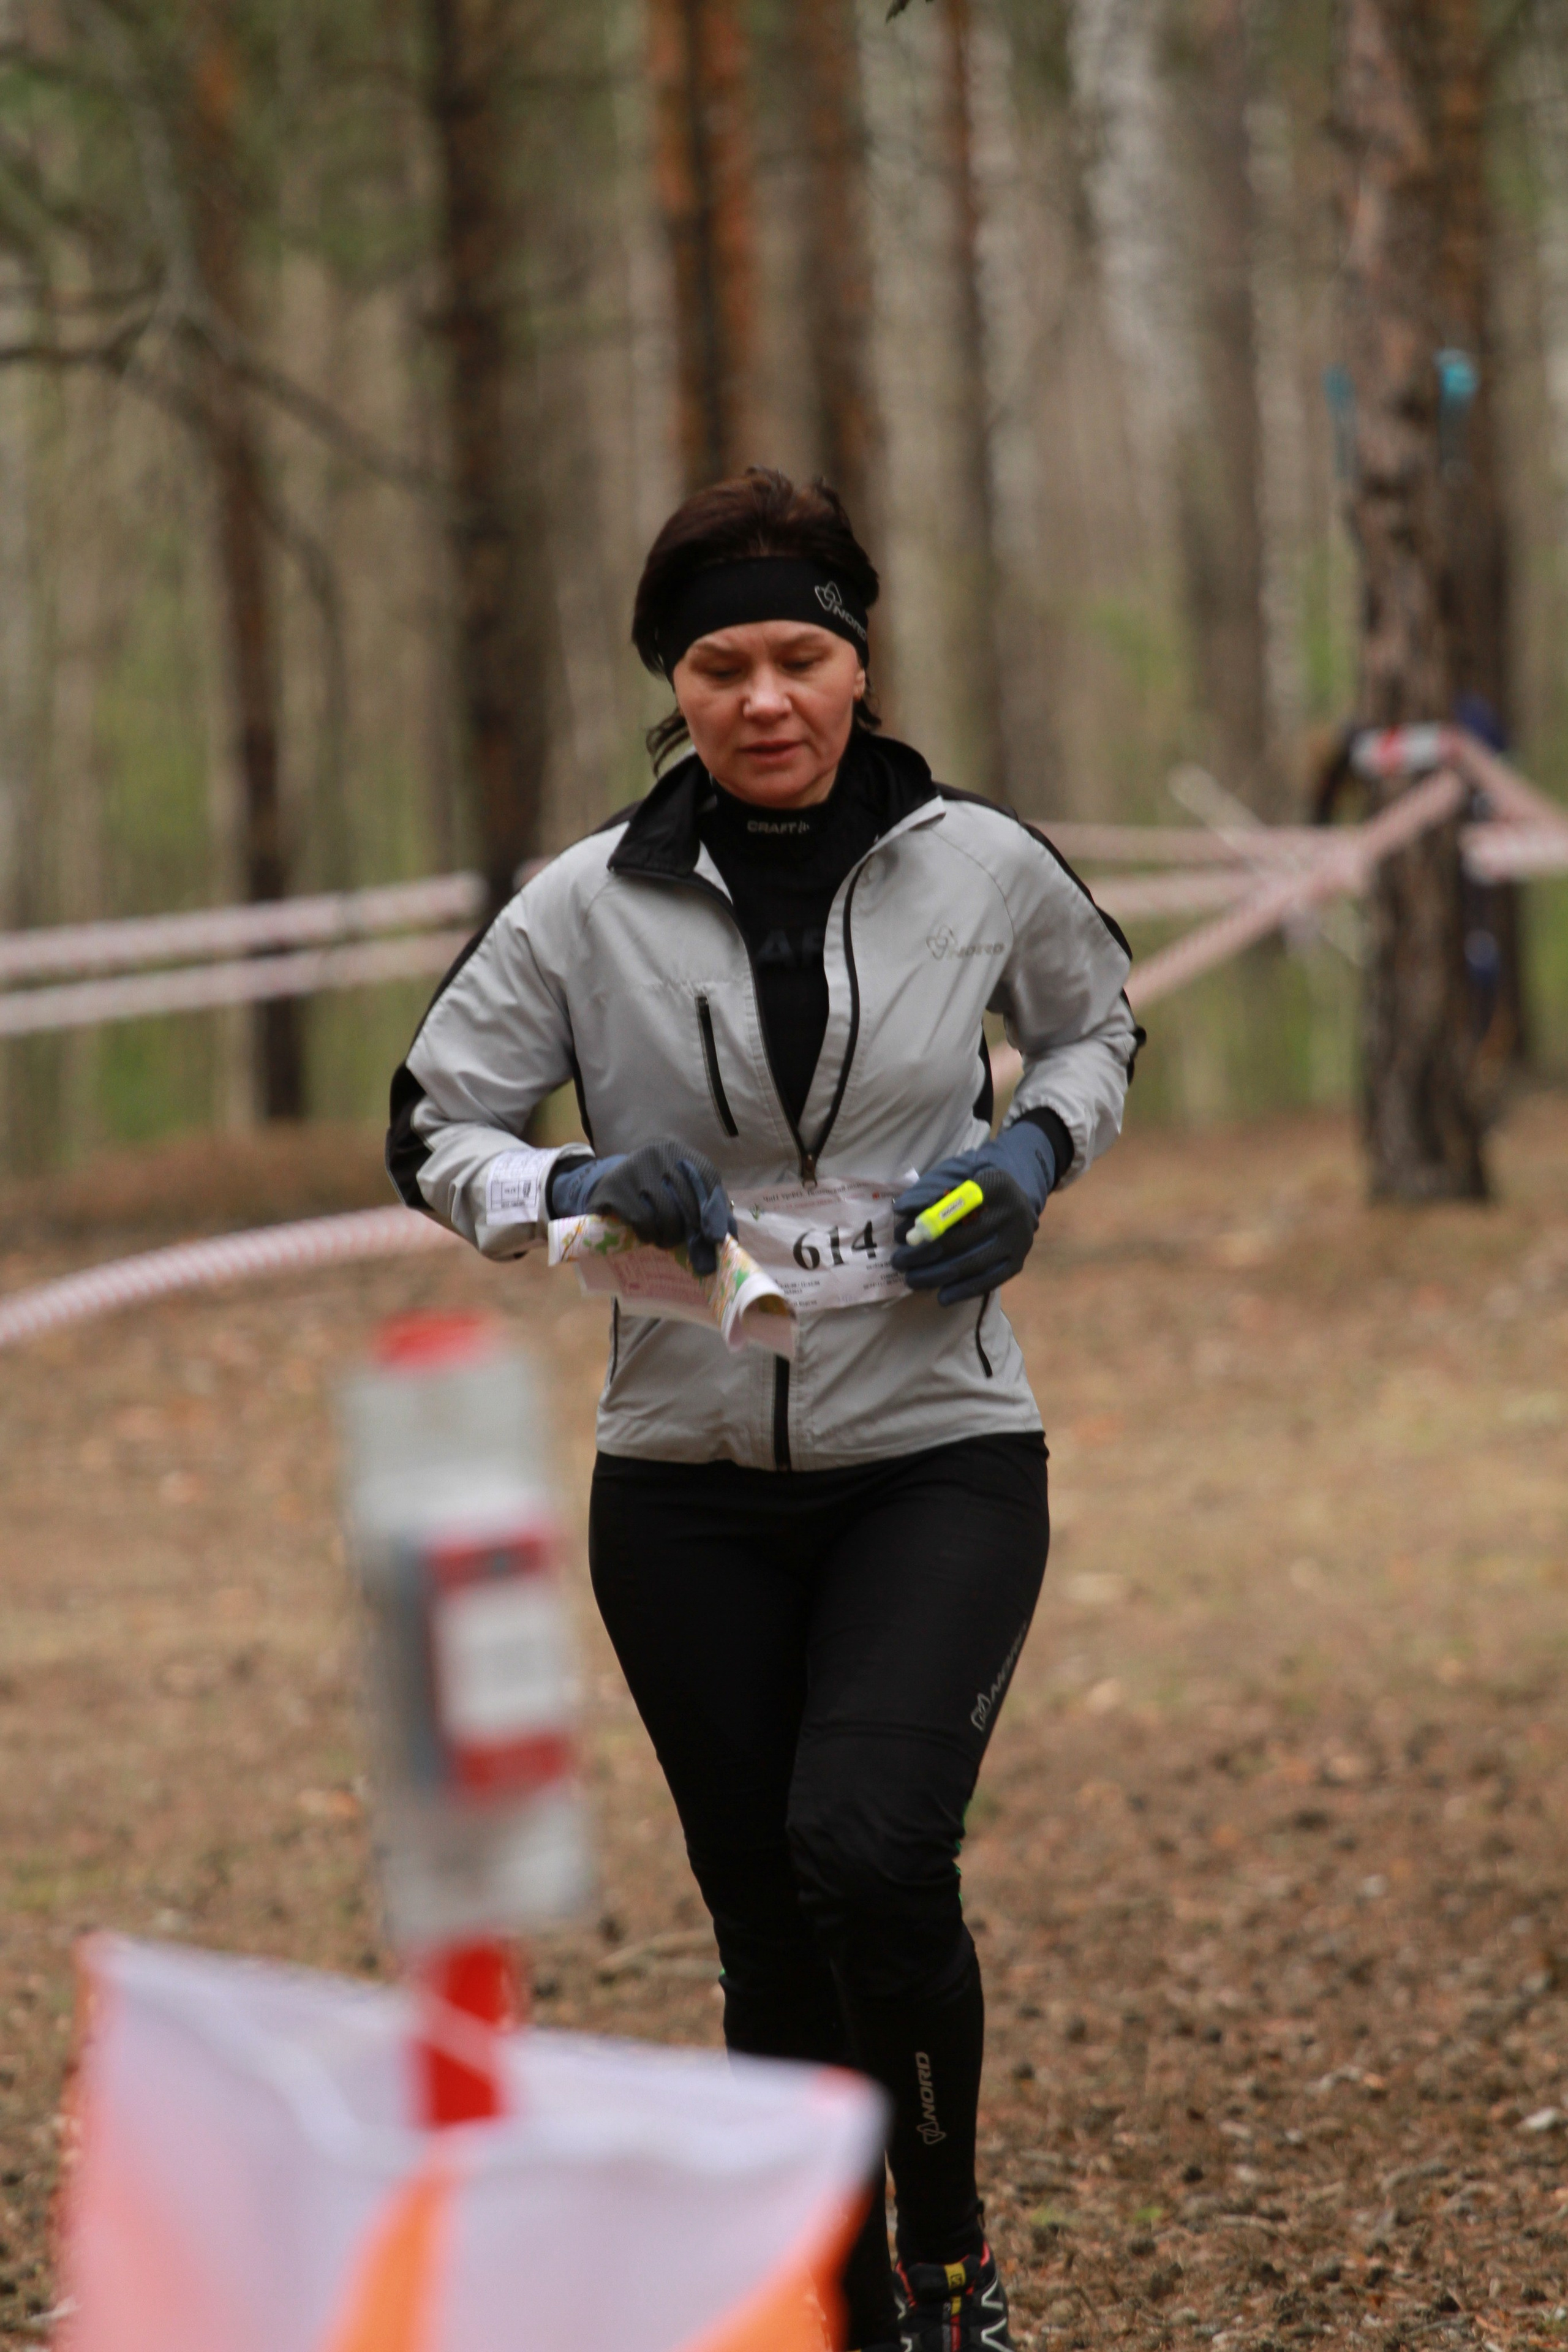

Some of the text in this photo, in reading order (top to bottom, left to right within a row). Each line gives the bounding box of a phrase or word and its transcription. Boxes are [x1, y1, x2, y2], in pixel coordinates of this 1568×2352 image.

[747, 820, 797, 834] CRAFT
[793, 1219, 877, 1270] 614
[915, 2051, 937, 2121] NORD
